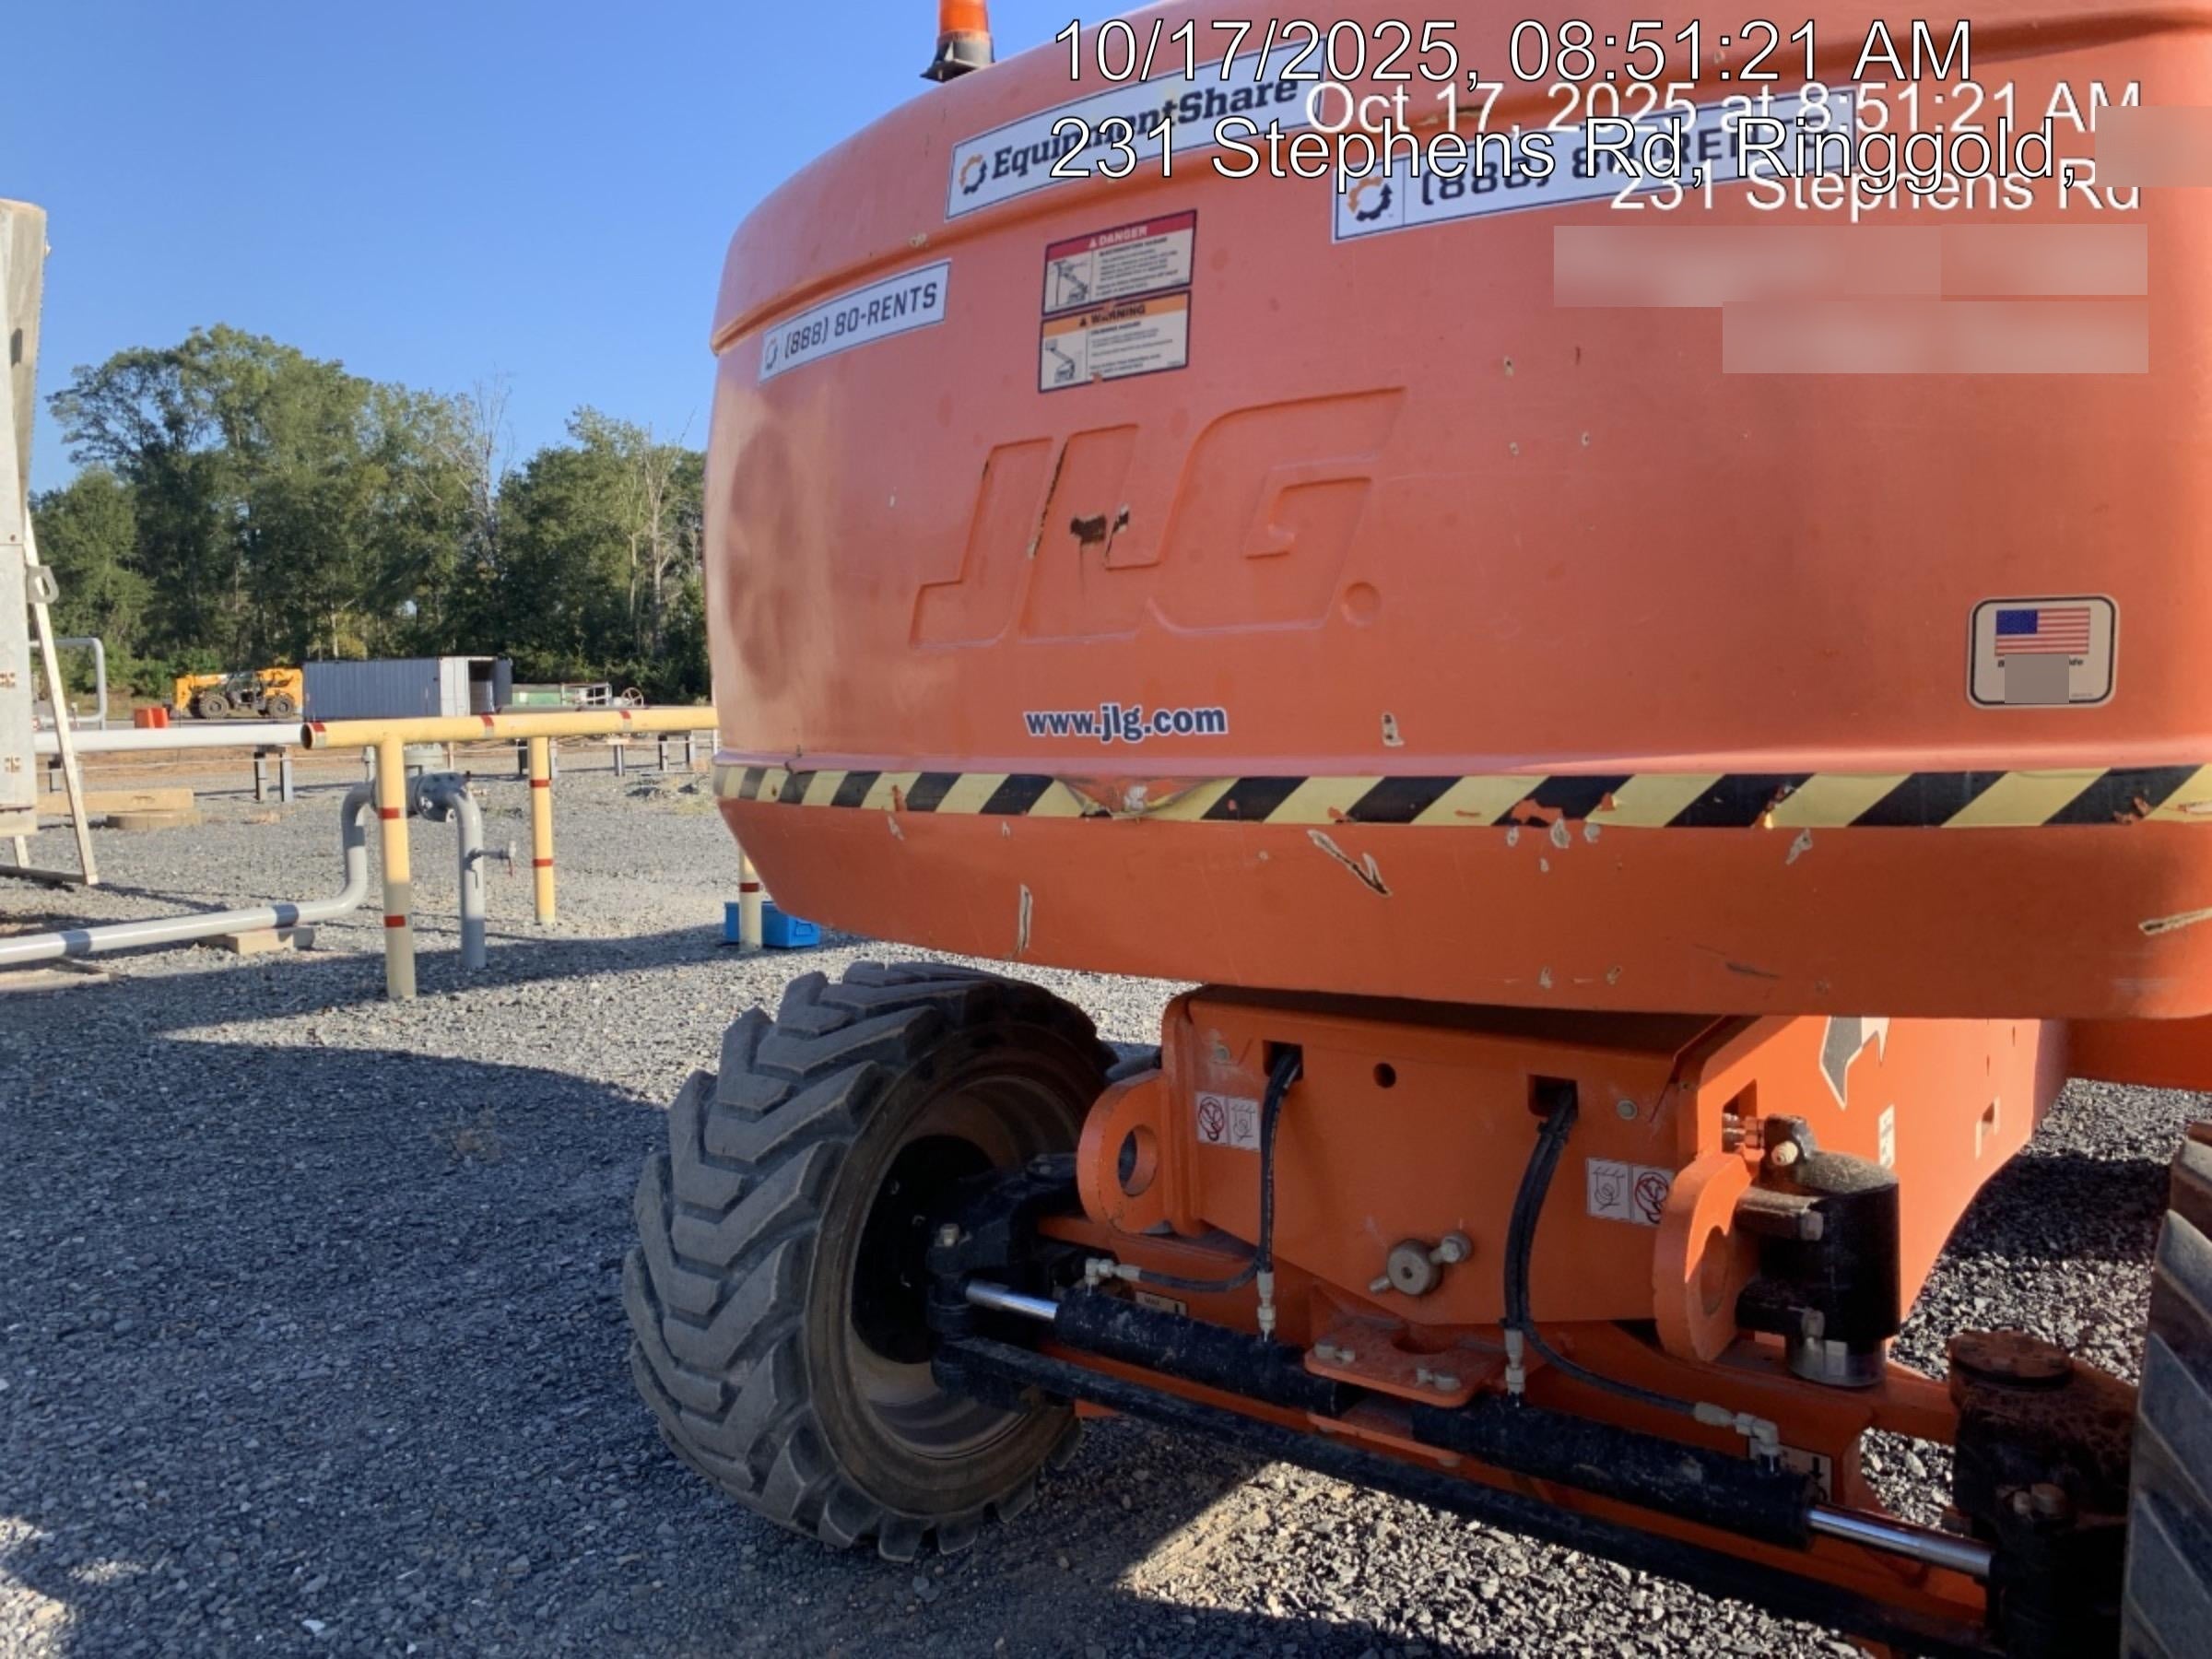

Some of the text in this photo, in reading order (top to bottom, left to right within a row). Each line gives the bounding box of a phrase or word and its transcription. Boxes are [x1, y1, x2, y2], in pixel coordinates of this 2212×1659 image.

[1099, 225, 1148, 247] DANGER
[784, 281, 937, 359] (888) 80-RENTS
[1025, 703, 1229, 743] www.jlg.com
